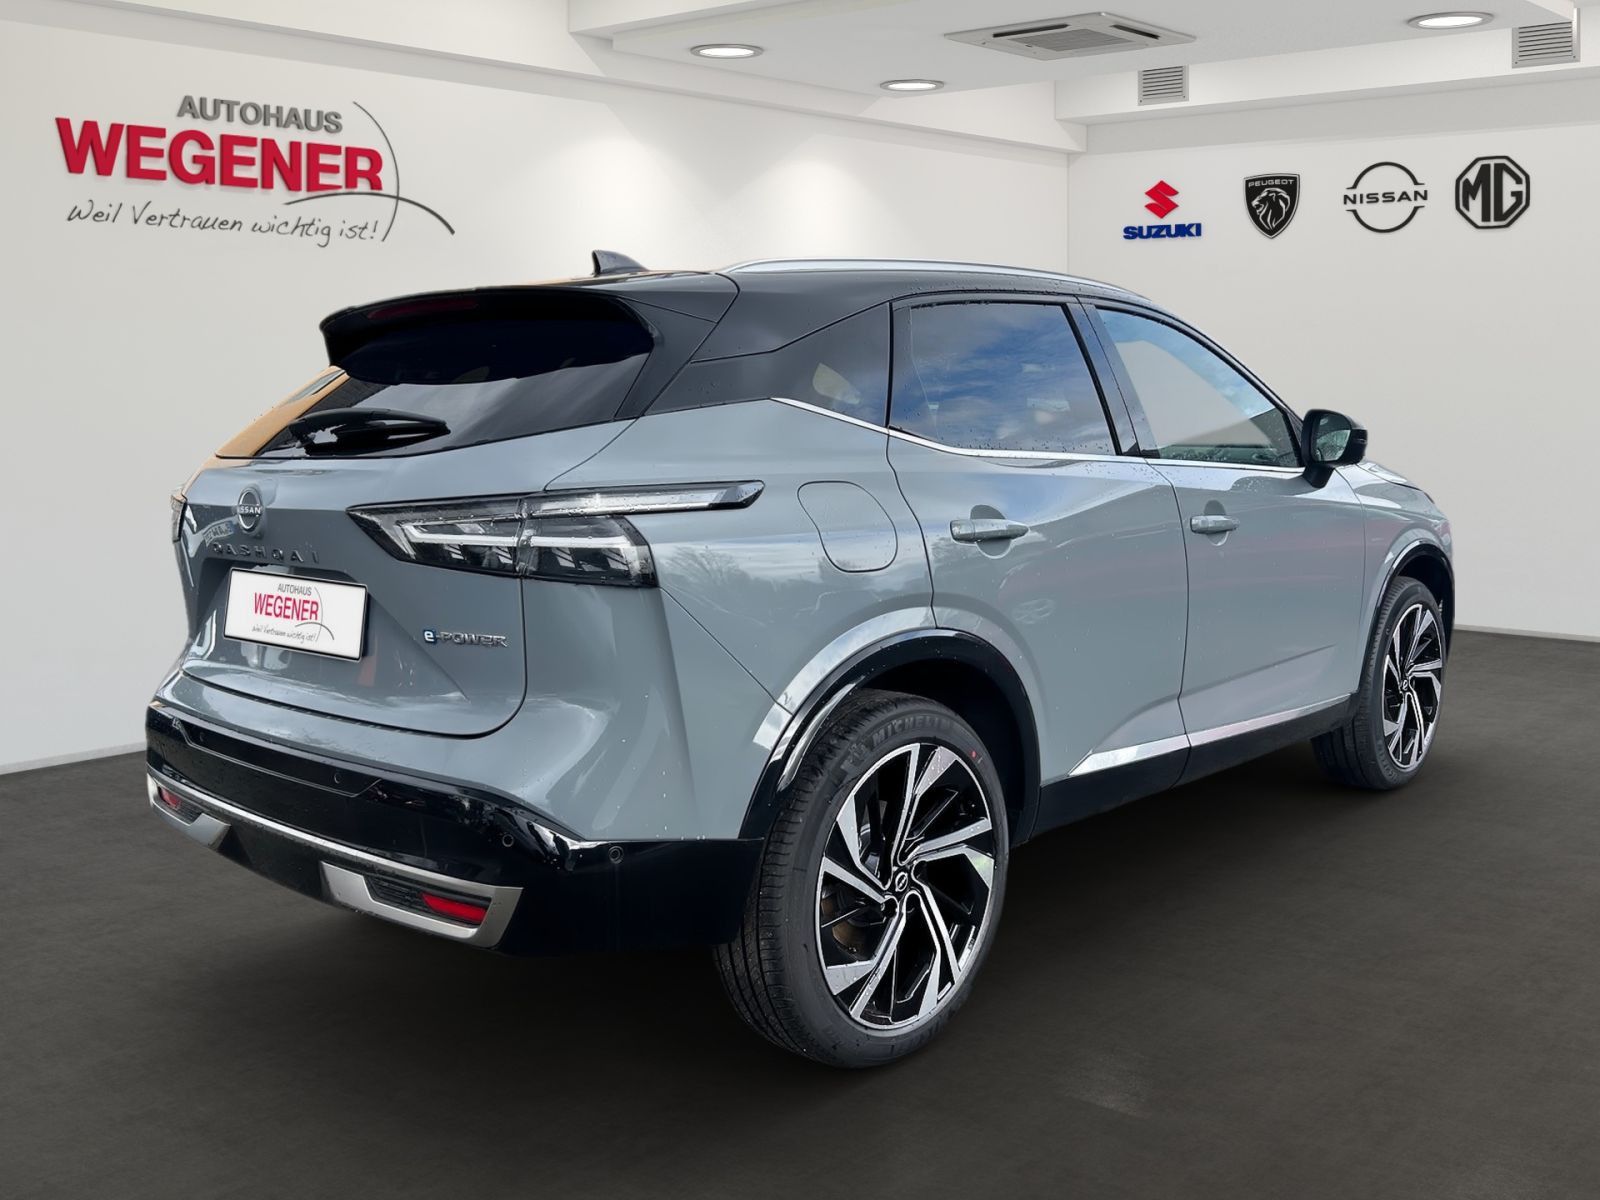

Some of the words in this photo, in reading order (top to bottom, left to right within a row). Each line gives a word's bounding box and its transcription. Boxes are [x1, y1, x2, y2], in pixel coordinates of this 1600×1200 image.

[177, 95, 343, 134] AUTOHAUS
[55, 117, 384, 192] WEGENER
[1248, 178, 1295, 188] PEUGEOT
[1461, 162, 1524, 224] MG
[1343, 189, 1429, 206] NISSAN
[67, 200, 122, 223] Weil
[132, 200, 243, 232] Vertrauen
[251, 216, 332, 248] wichtig
[338, 220, 379, 241] ist!
[1123, 222, 1202, 240] SUZUKI
[212, 542, 320, 564] QASHQAI
[277, 583, 312, 597] AUTOHAUS
[254, 592, 320, 621] WEGENER
[424, 630, 509, 647] e-POWER
